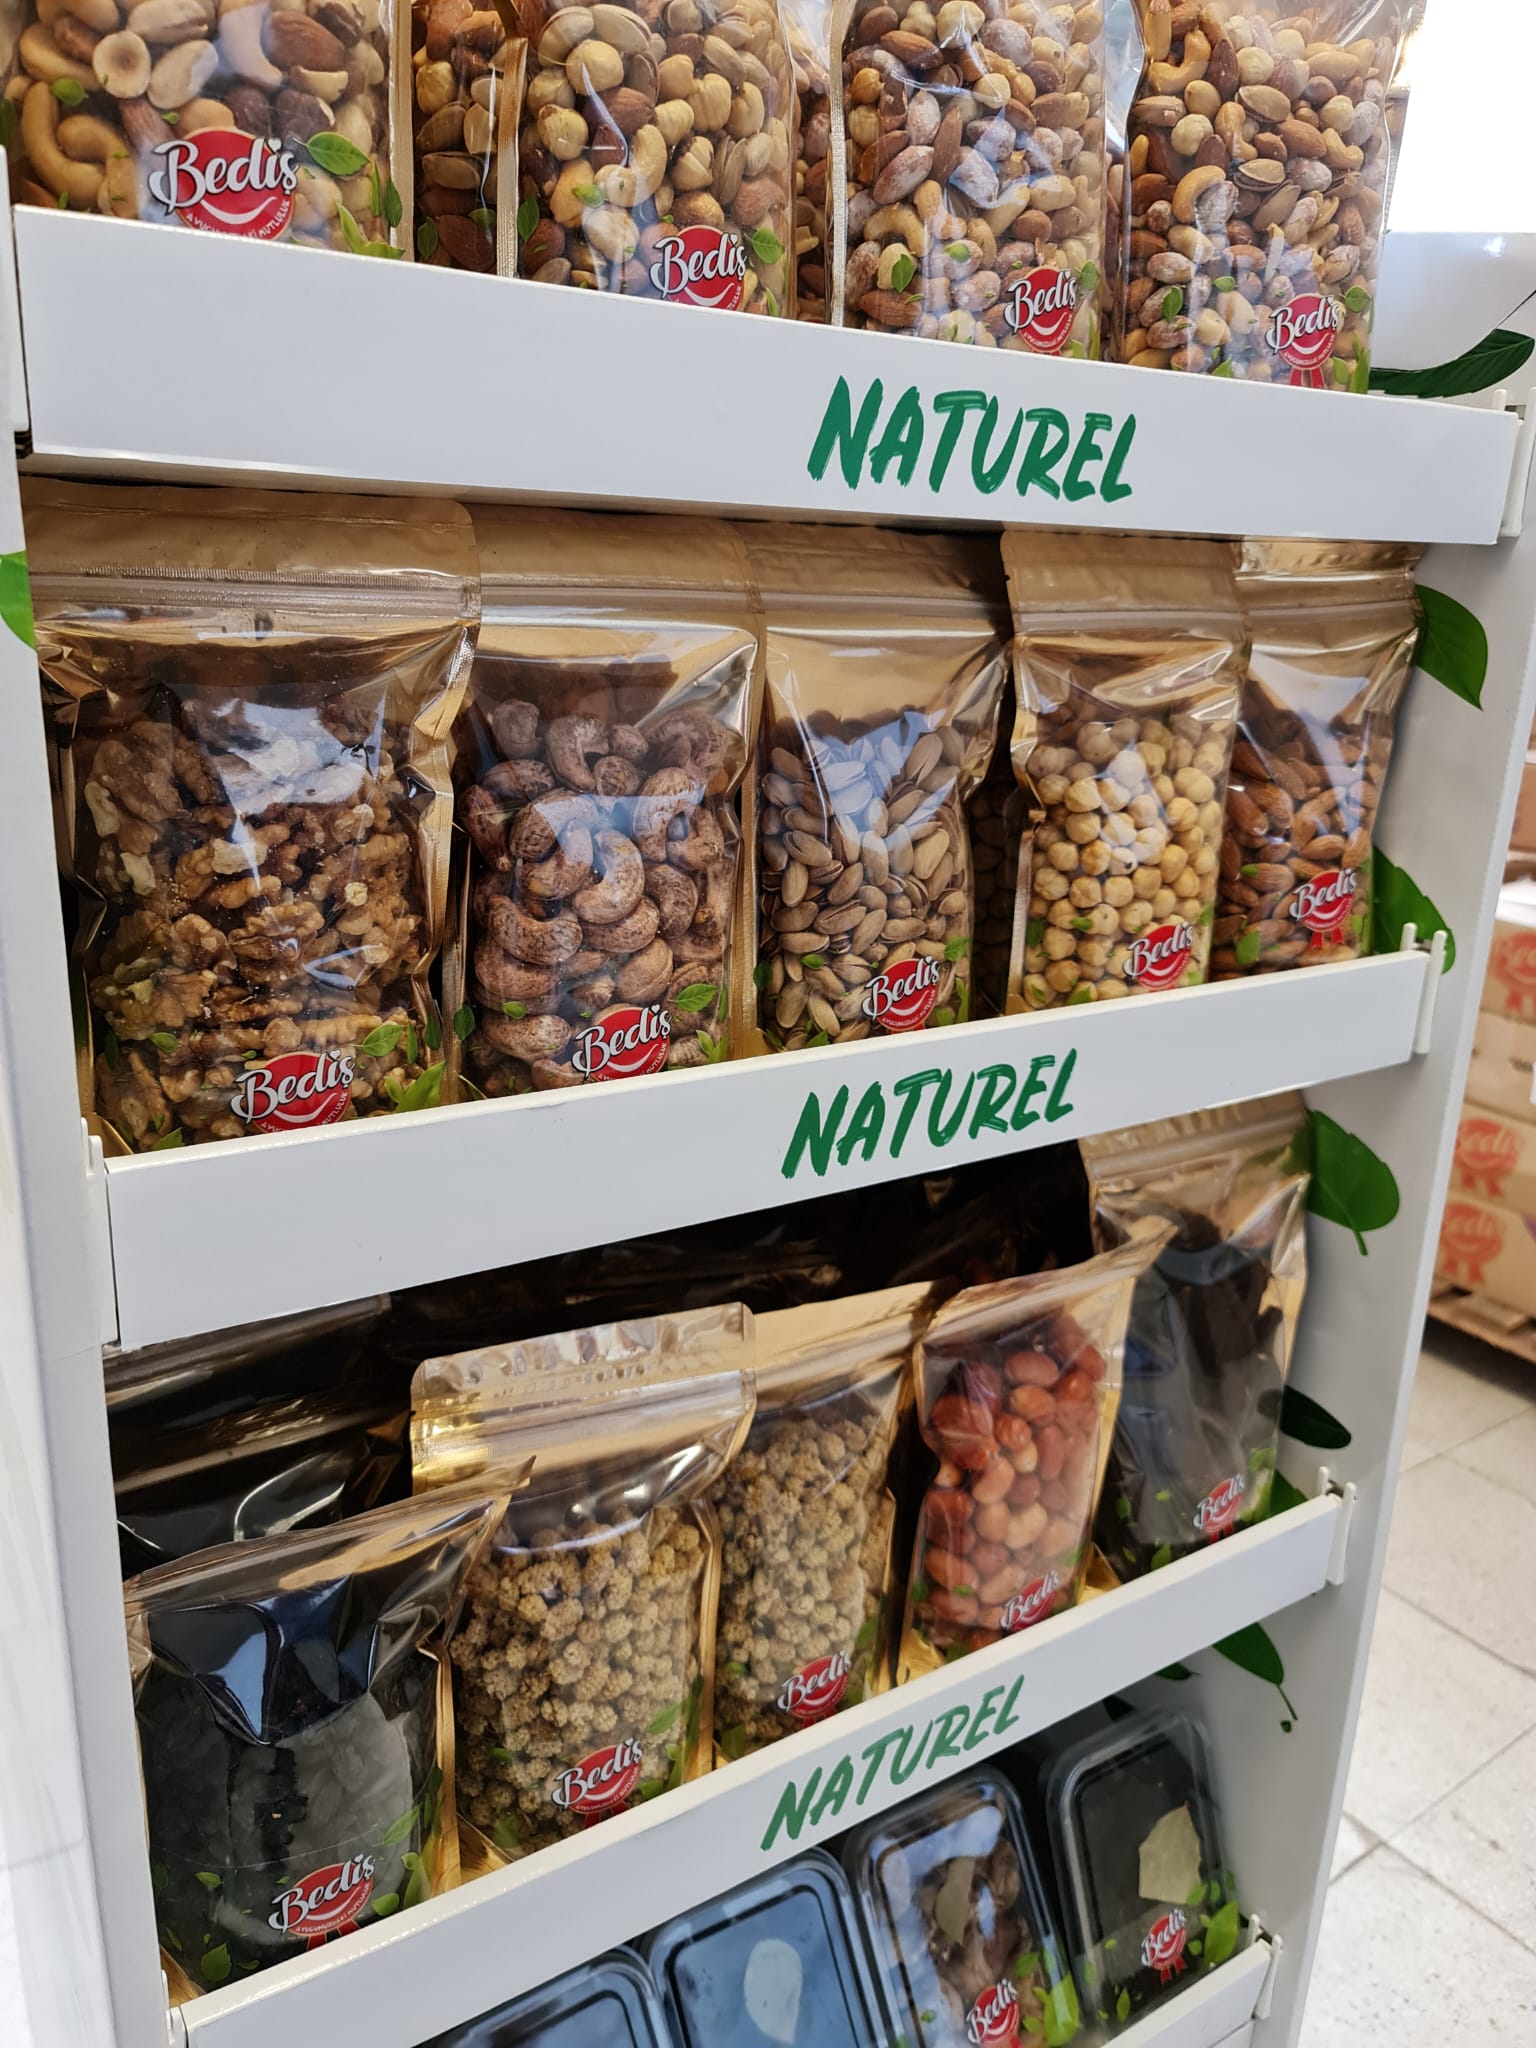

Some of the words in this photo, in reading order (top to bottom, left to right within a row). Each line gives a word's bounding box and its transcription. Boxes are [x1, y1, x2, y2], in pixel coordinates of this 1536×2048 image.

[807, 375, 1136, 503] NATUREL
[781, 1048, 1077, 1179] NATUREL
[760, 1674, 1024, 1851] NATUREL
